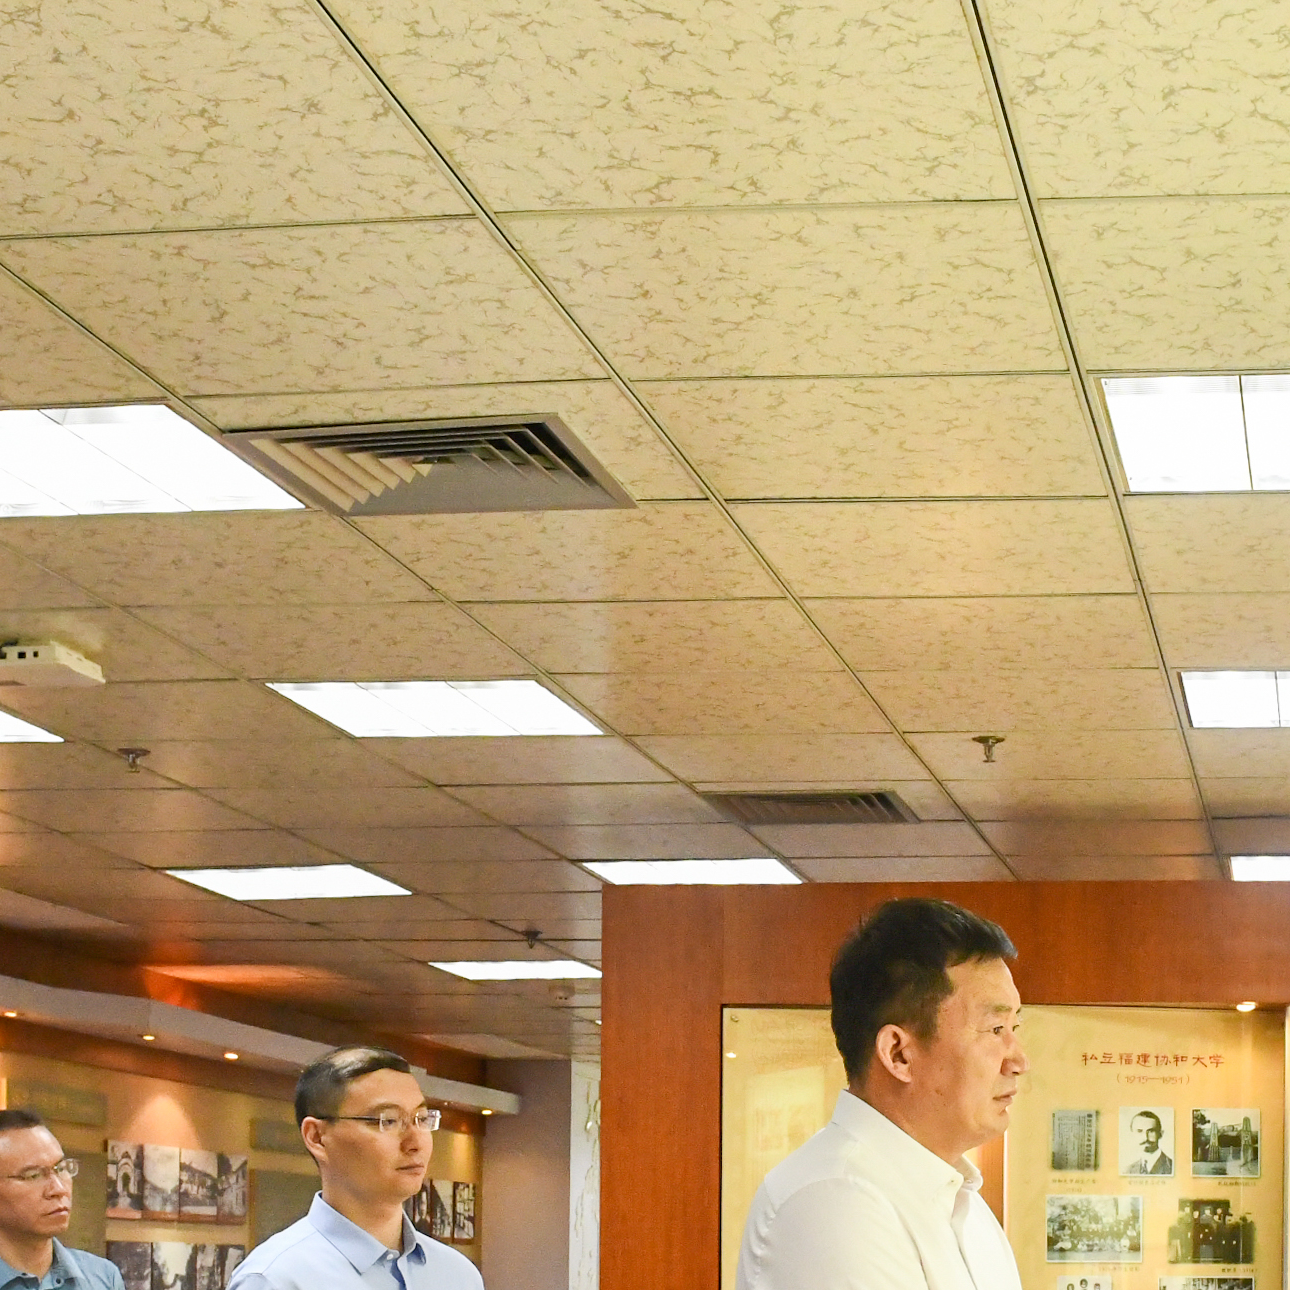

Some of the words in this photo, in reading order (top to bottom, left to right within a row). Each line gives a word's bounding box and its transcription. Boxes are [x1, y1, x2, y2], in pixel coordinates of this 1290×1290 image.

[1081, 1051, 1226, 1068] 私立福建协和大学
